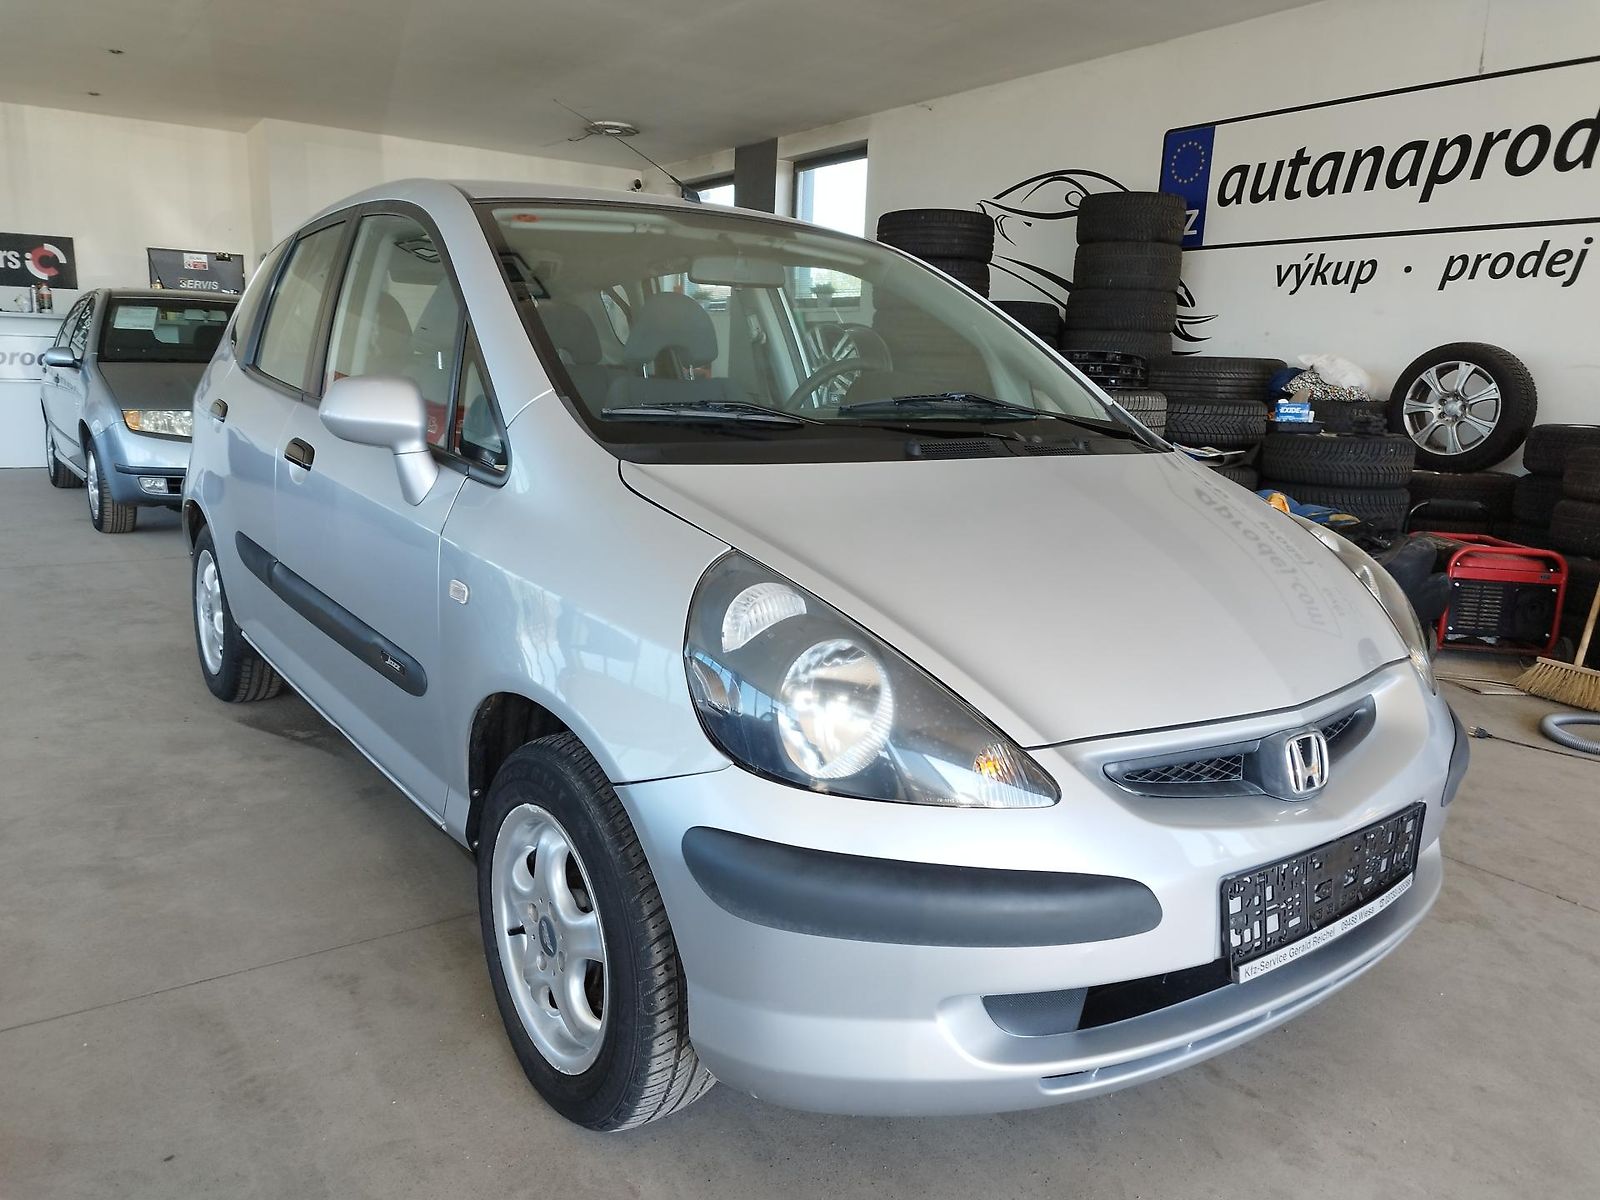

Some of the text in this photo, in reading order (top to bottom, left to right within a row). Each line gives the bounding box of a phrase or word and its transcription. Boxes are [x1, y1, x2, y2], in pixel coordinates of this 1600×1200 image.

[1217, 104, 1600, 207] autanaprod
[180, 279, 219, 290] SERVIS
[1275, 237, 1594, 295] výkup prodej
[1244, 952, 1288, 978] Kfz-Service
[1288, 941, 1312, 958] Gerald
